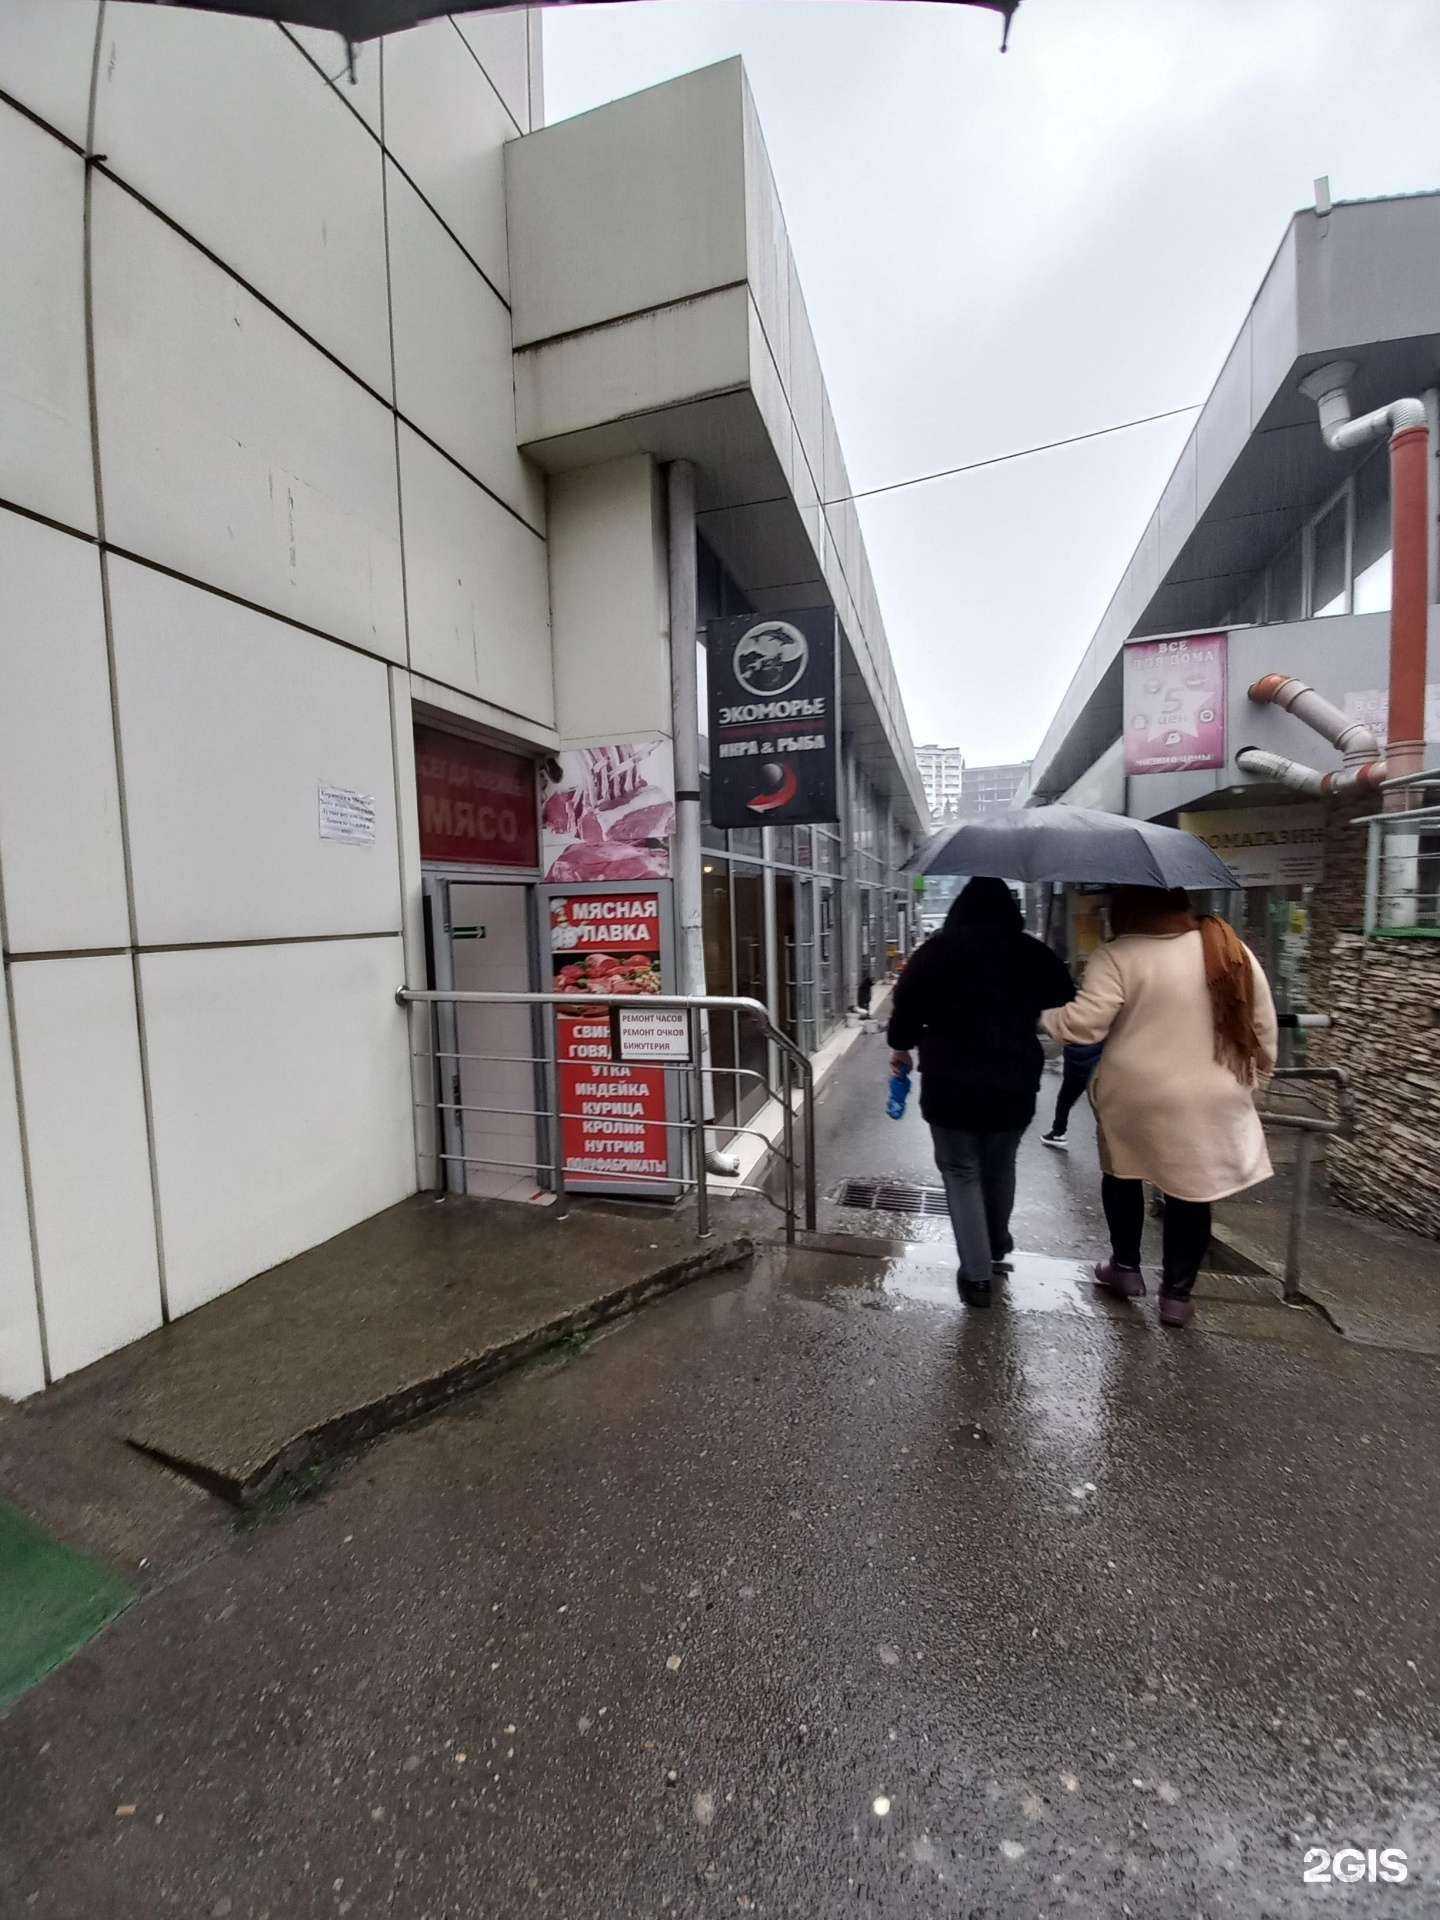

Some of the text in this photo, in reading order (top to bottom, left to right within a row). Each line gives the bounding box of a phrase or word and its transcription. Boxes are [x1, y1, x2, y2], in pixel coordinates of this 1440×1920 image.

[1158, 640, 1188, 654] ВСЕ
[718, 697, 827, 725] ЭКОМОРЬЕ
[718, 734, 827, 759] ИКРА & РЫБА
[421, 795, 519, 843] МЯСО
[571, 899, 658, 920] МЯСНАЯ
[580, 923, 651, 942] ЛАВКА
[622, 1014, 683, 1023] РЕМОНТ ЧАСОВ
[622, 1028, 685, 1037] РЕМОНТ ОЧКОВ
[623, 1041, 671, 1051] БИЖУТЕРИЯ
[591, 1064, 632, 1077] УТКА
[574, 1080, 650, 1098] ИНДЕЙКА
[582, 1101, 645, 1117] КУРИЦА
[582, 1121, 646, 1135] КРОЛИК
[584, 1139, 645, 1154] НУТРИЯ
